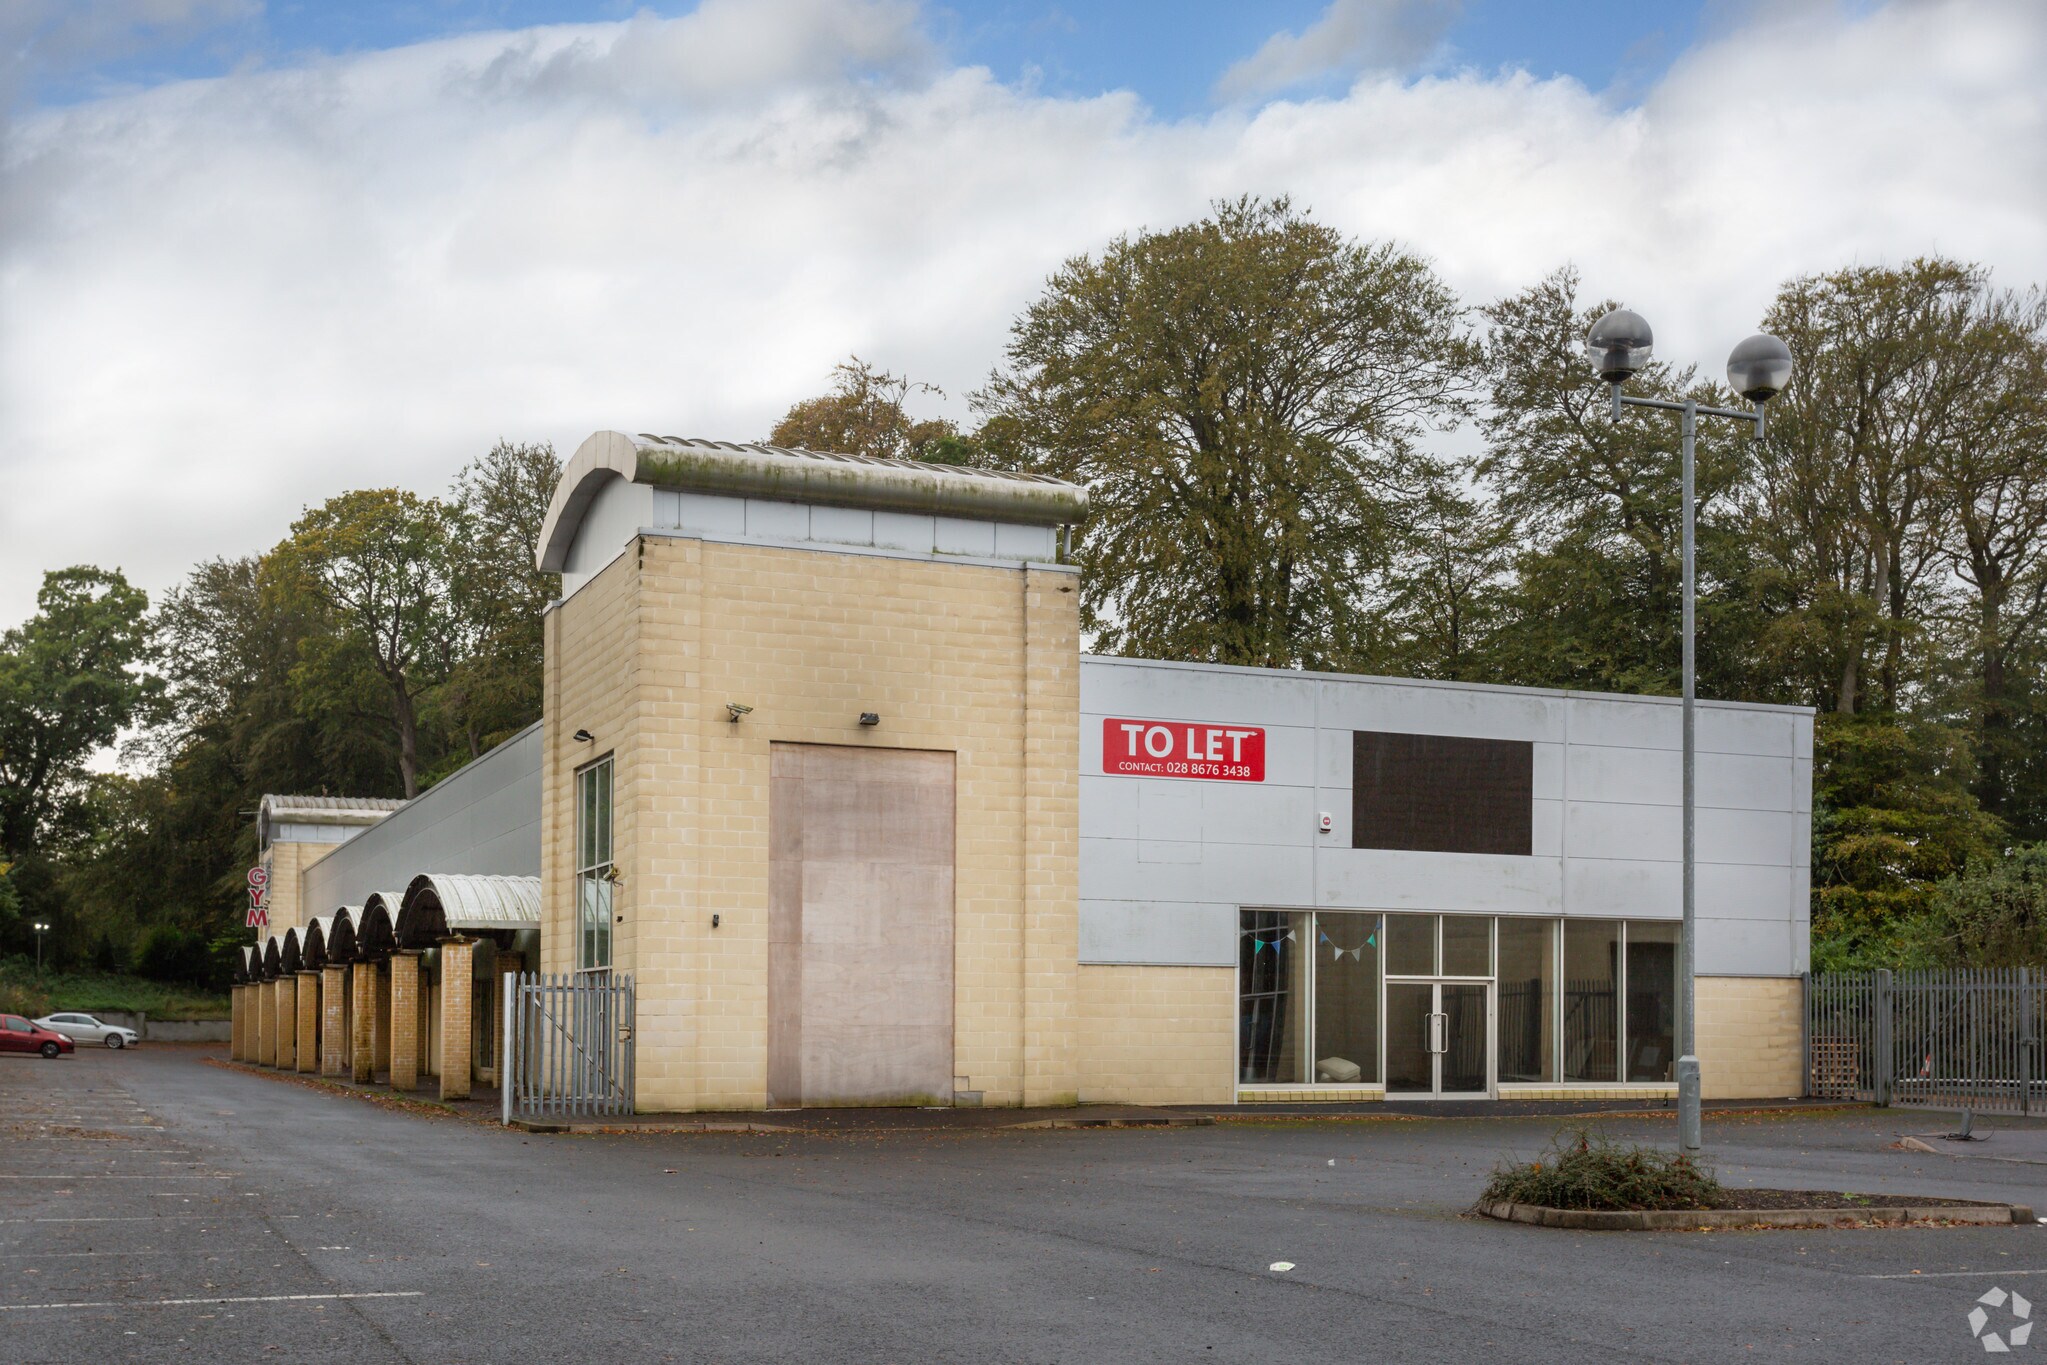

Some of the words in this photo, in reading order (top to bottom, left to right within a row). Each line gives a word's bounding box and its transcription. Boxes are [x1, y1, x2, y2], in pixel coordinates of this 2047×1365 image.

[1120, 723, 1174, 758] TO
[1186, 727, 1250, 762] LET
[1118, 761, 1164, 773] CONTACT:
[1166, 762, 1188, 774] 028
[1191, 763, 1219, 775] 8676
[1222, 765, 1251, 777] 3438
[246, 867, 268, 927] GYM
